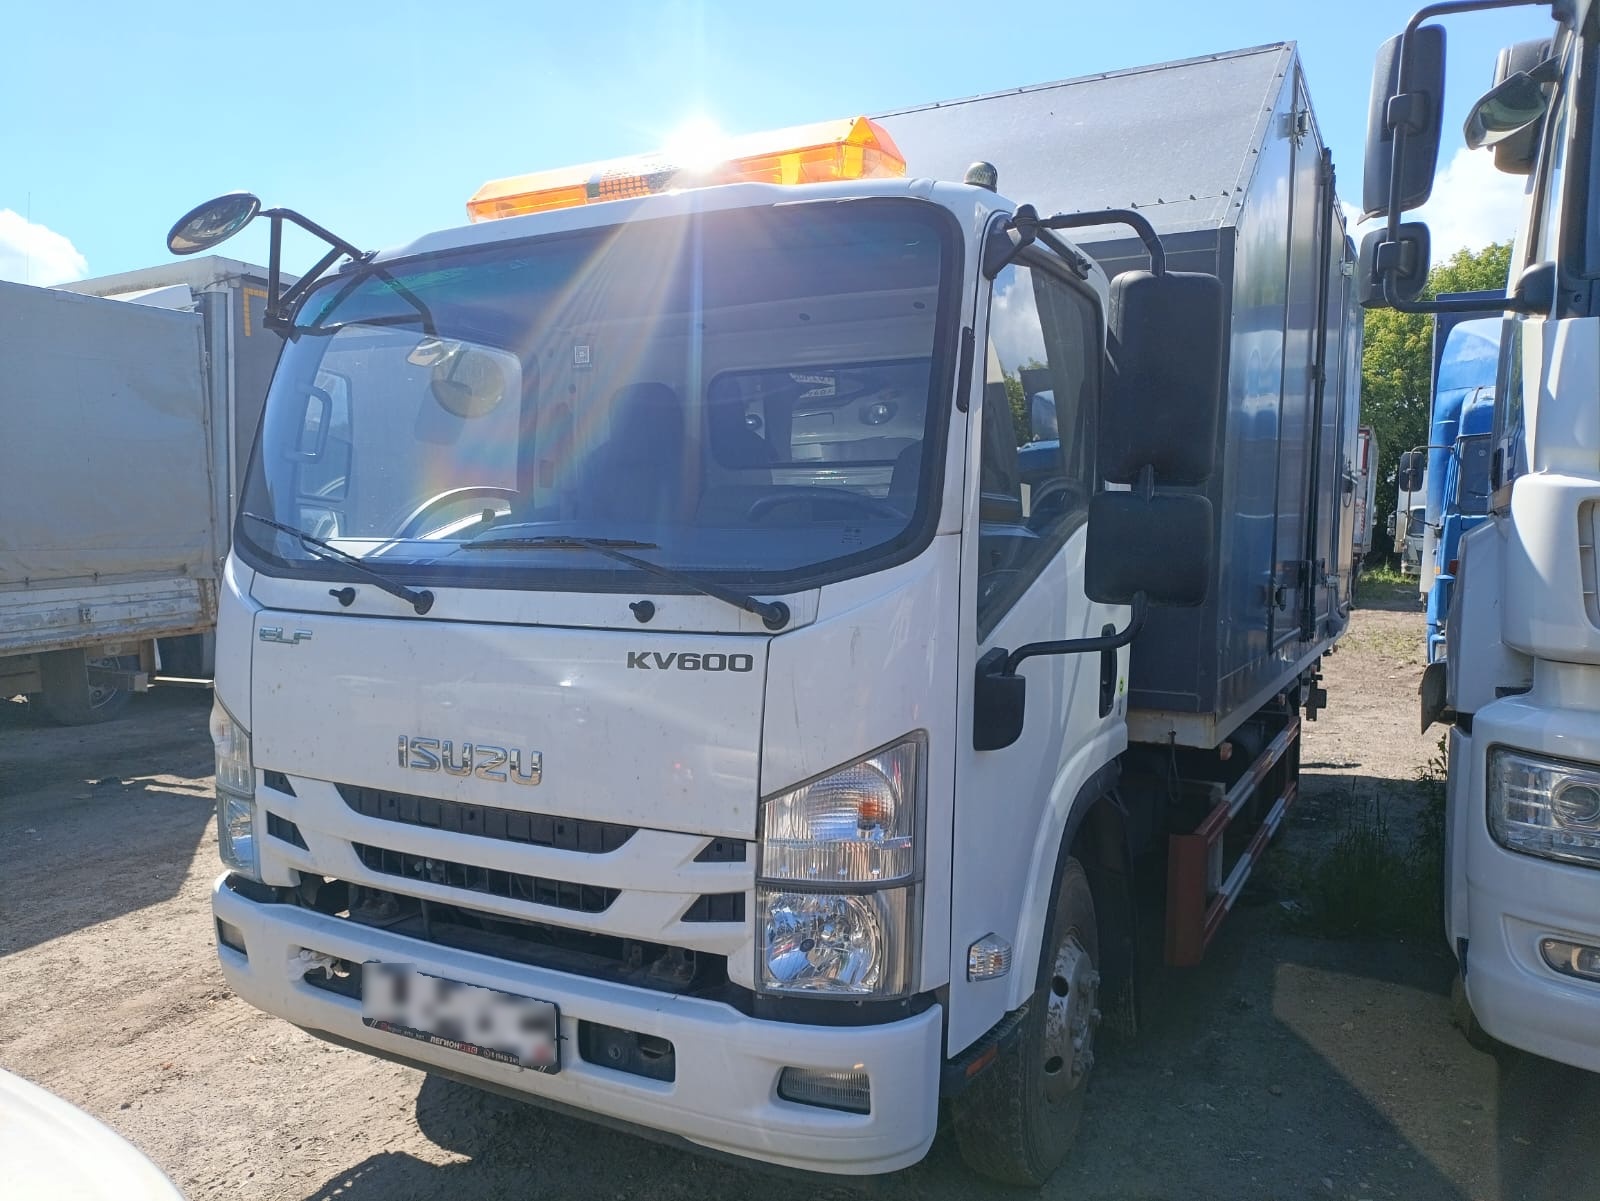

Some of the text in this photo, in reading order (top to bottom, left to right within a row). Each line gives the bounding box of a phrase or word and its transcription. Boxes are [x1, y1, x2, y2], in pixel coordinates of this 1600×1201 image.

[259, 626, 313, 644] ELF
[626, 651, 754, 673] KV600
[398, 734, 543, 786] ISUZU
